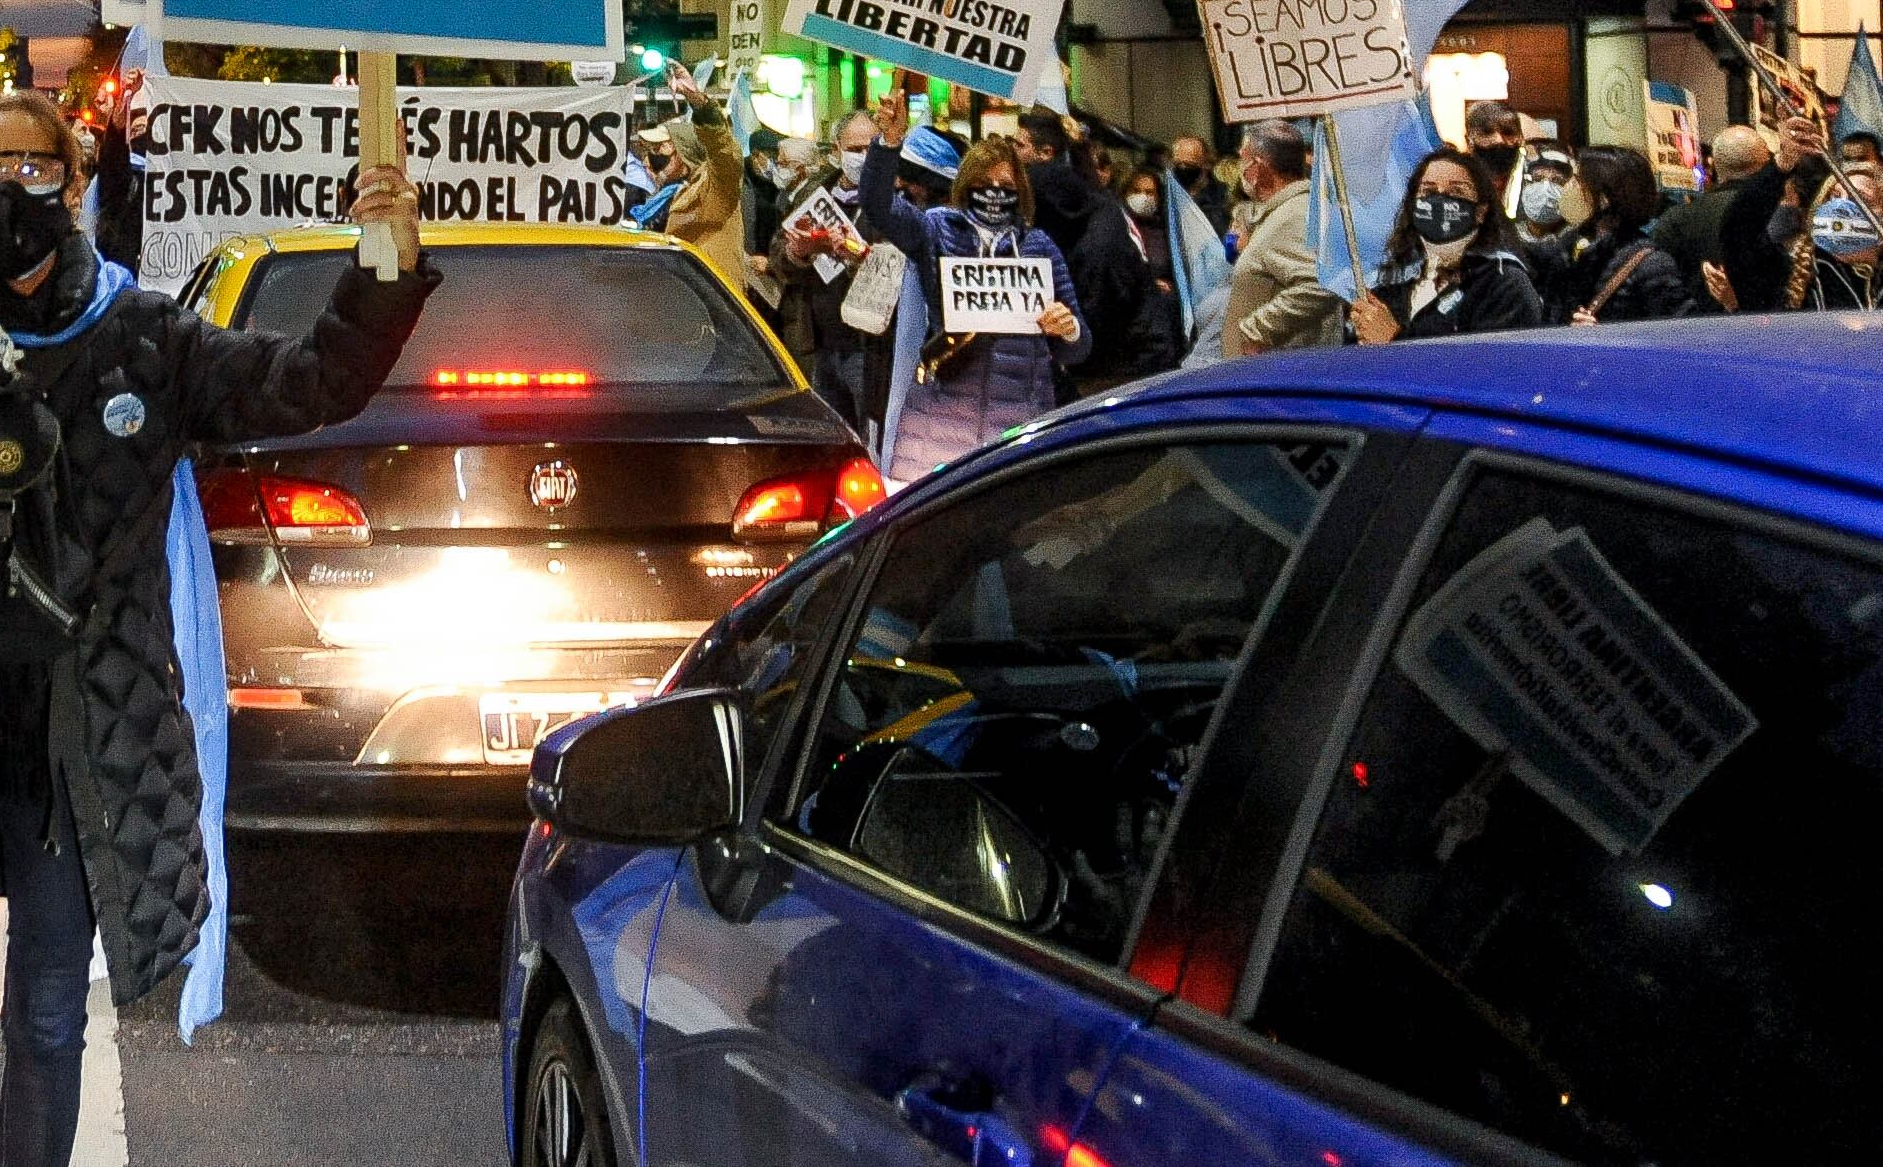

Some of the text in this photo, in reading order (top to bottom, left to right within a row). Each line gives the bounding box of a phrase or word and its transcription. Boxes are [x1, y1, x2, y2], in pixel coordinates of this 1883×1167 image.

[737, 2, 759, 22] NO
[732, 32, 761, 50] DEN
[146, 104, 226, 156] CFK
[230, 105, 304, 154] NOS
[310, 96, 442, 159] TEÉS
[145, 165, 253, 223] ESTAS
[486, 177, 526, 222] EL
[538, 174, 627, 226] PAIS
[950, 263, 1044, 289] CRISTINA
[953, 290, 1045, 313] PRESA YA
